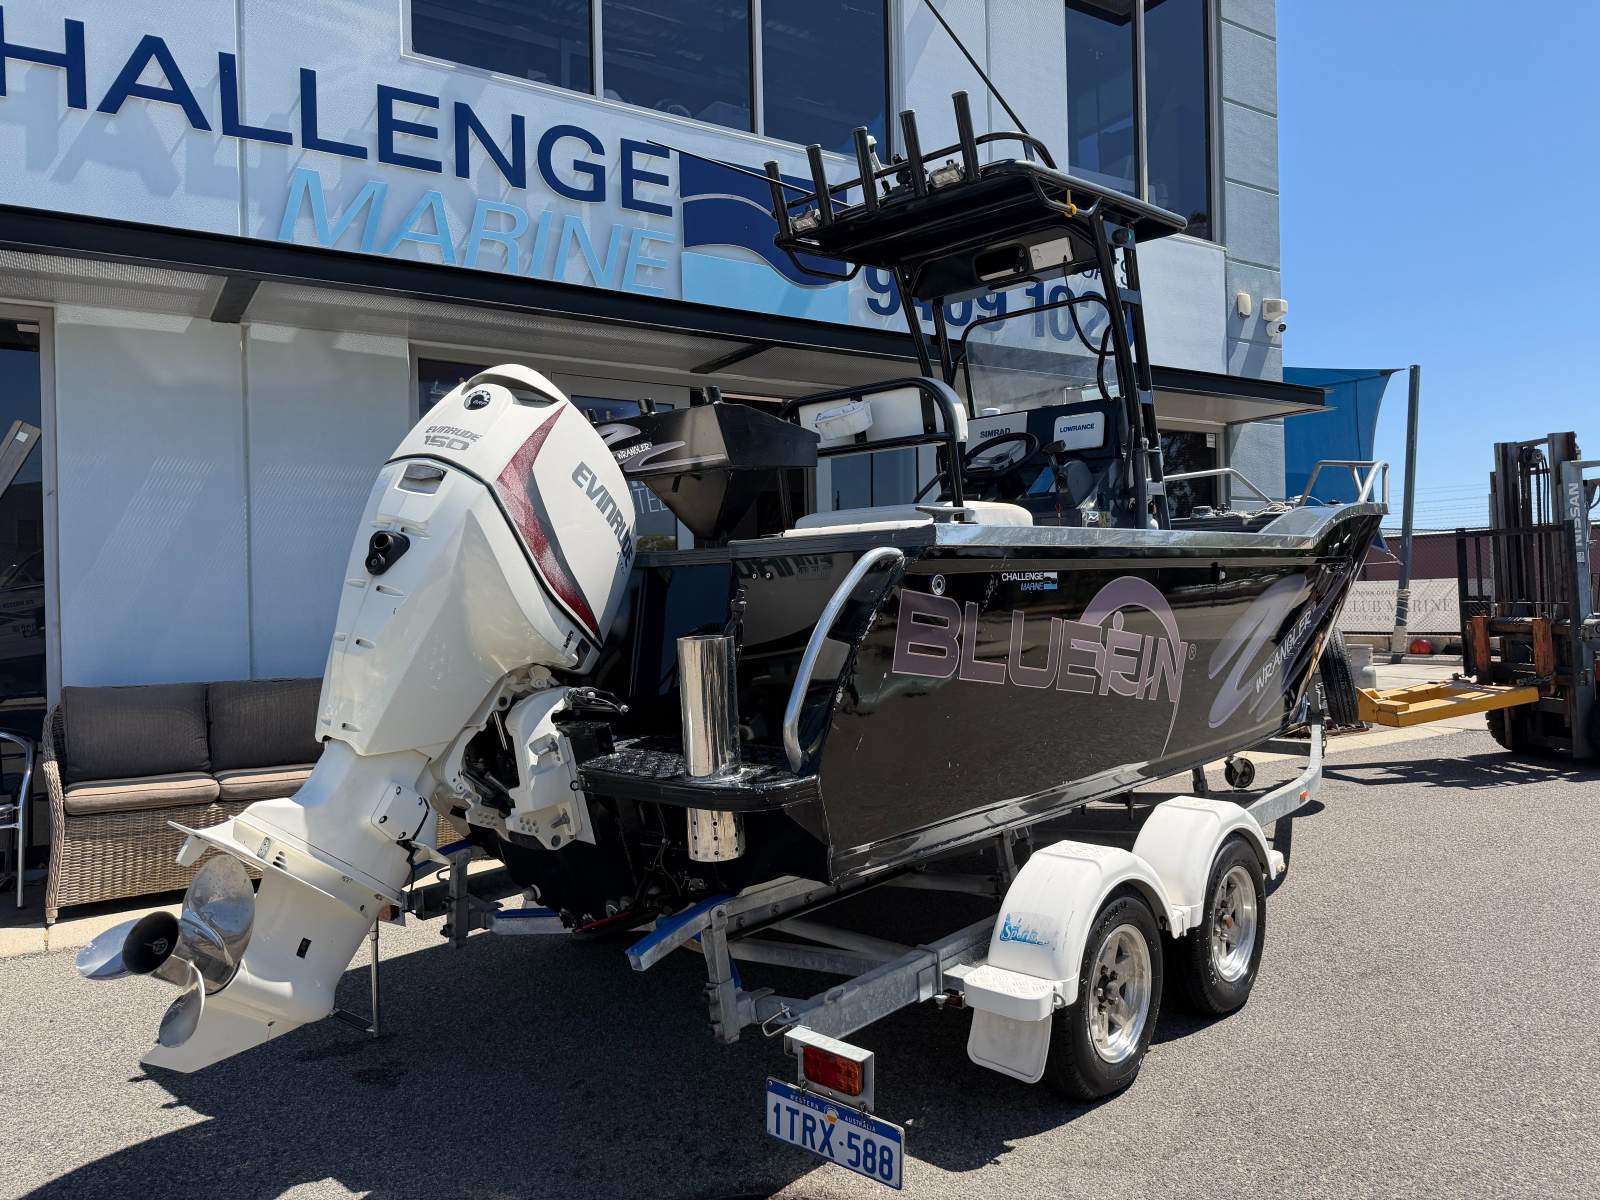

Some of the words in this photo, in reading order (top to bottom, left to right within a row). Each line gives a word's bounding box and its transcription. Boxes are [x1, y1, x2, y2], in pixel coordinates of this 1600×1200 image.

[0, 5, 673, 217] HALLENGE
[278, 167, 675, 299] MARINE
[425, 425, 483, 442] EVINRUDE
[980, 427, 1011, 438] SIMRAD
[1059, 423, 1095, 433] LOWRANCE
[424, 435, 470, 450] 150
[617, 442, 653, 459] WRANGLER
[1001, 572, 1044, 581] CHALLENGE
[892, 588, 1187, 703] BLUEFIN
[1255, 610, 1312, 693] WRANGLER
[844, 1115, 876, 1133] AUSTRALIA
